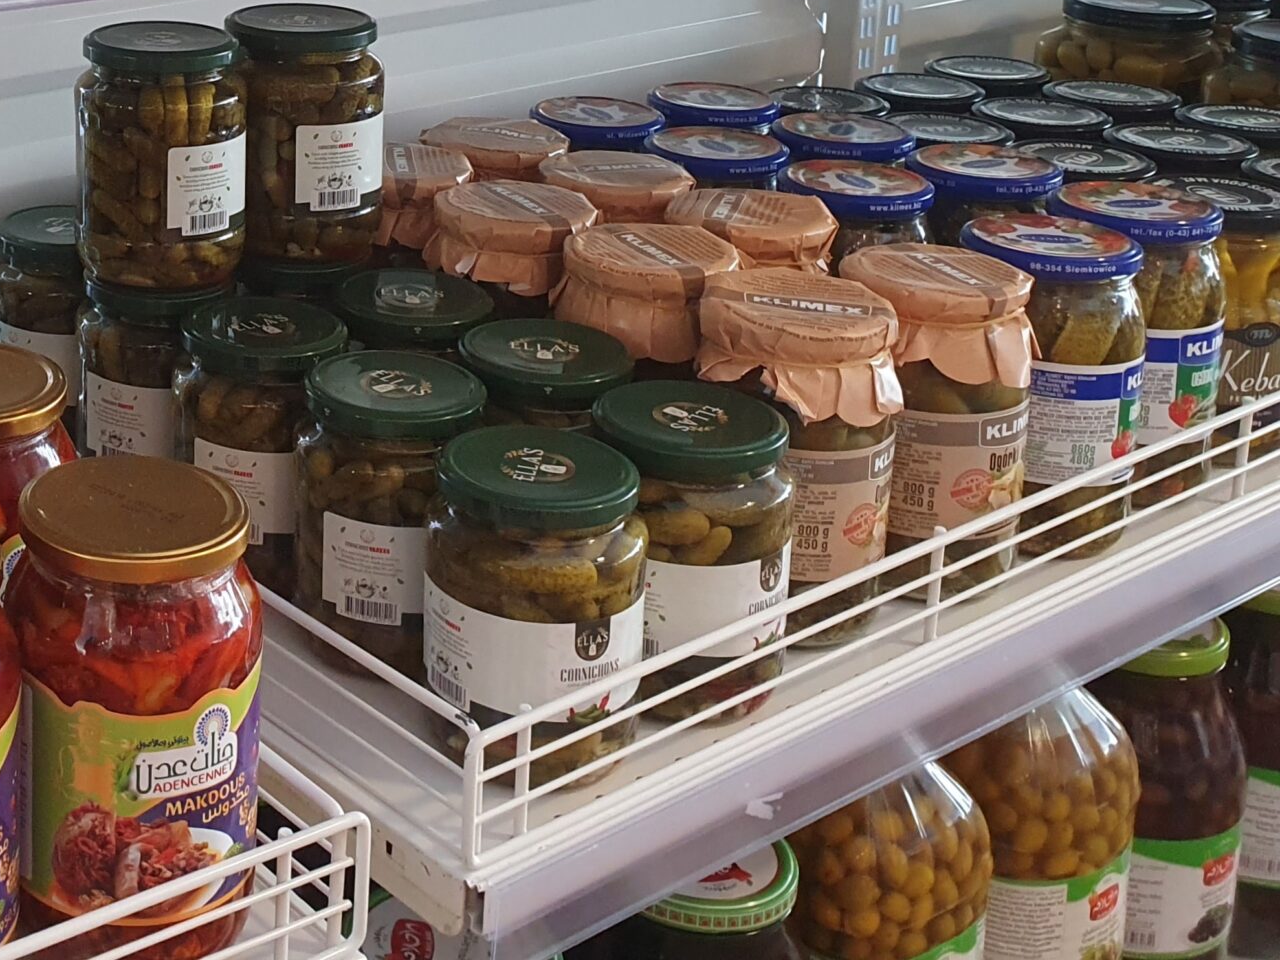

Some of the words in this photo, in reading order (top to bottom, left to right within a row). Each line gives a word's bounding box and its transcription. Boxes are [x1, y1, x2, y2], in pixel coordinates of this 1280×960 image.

[622, 233, 682, 266] KLIMEX
[753, 294, 865, 316] KLIMEX
[513, 447, 544, 482] ELLAS
[902, 495, 924, 508] 450
[798, 525, 819, 537] 800
[796, 538, 818, 550] 450
[577, 631, 609, 647] ELLAS
[560, 658, 620, 683] CORNICHONS
[153, 761, 233, 794] ADENCENNET
[165, 772, 246, 818] MAKDOUS
